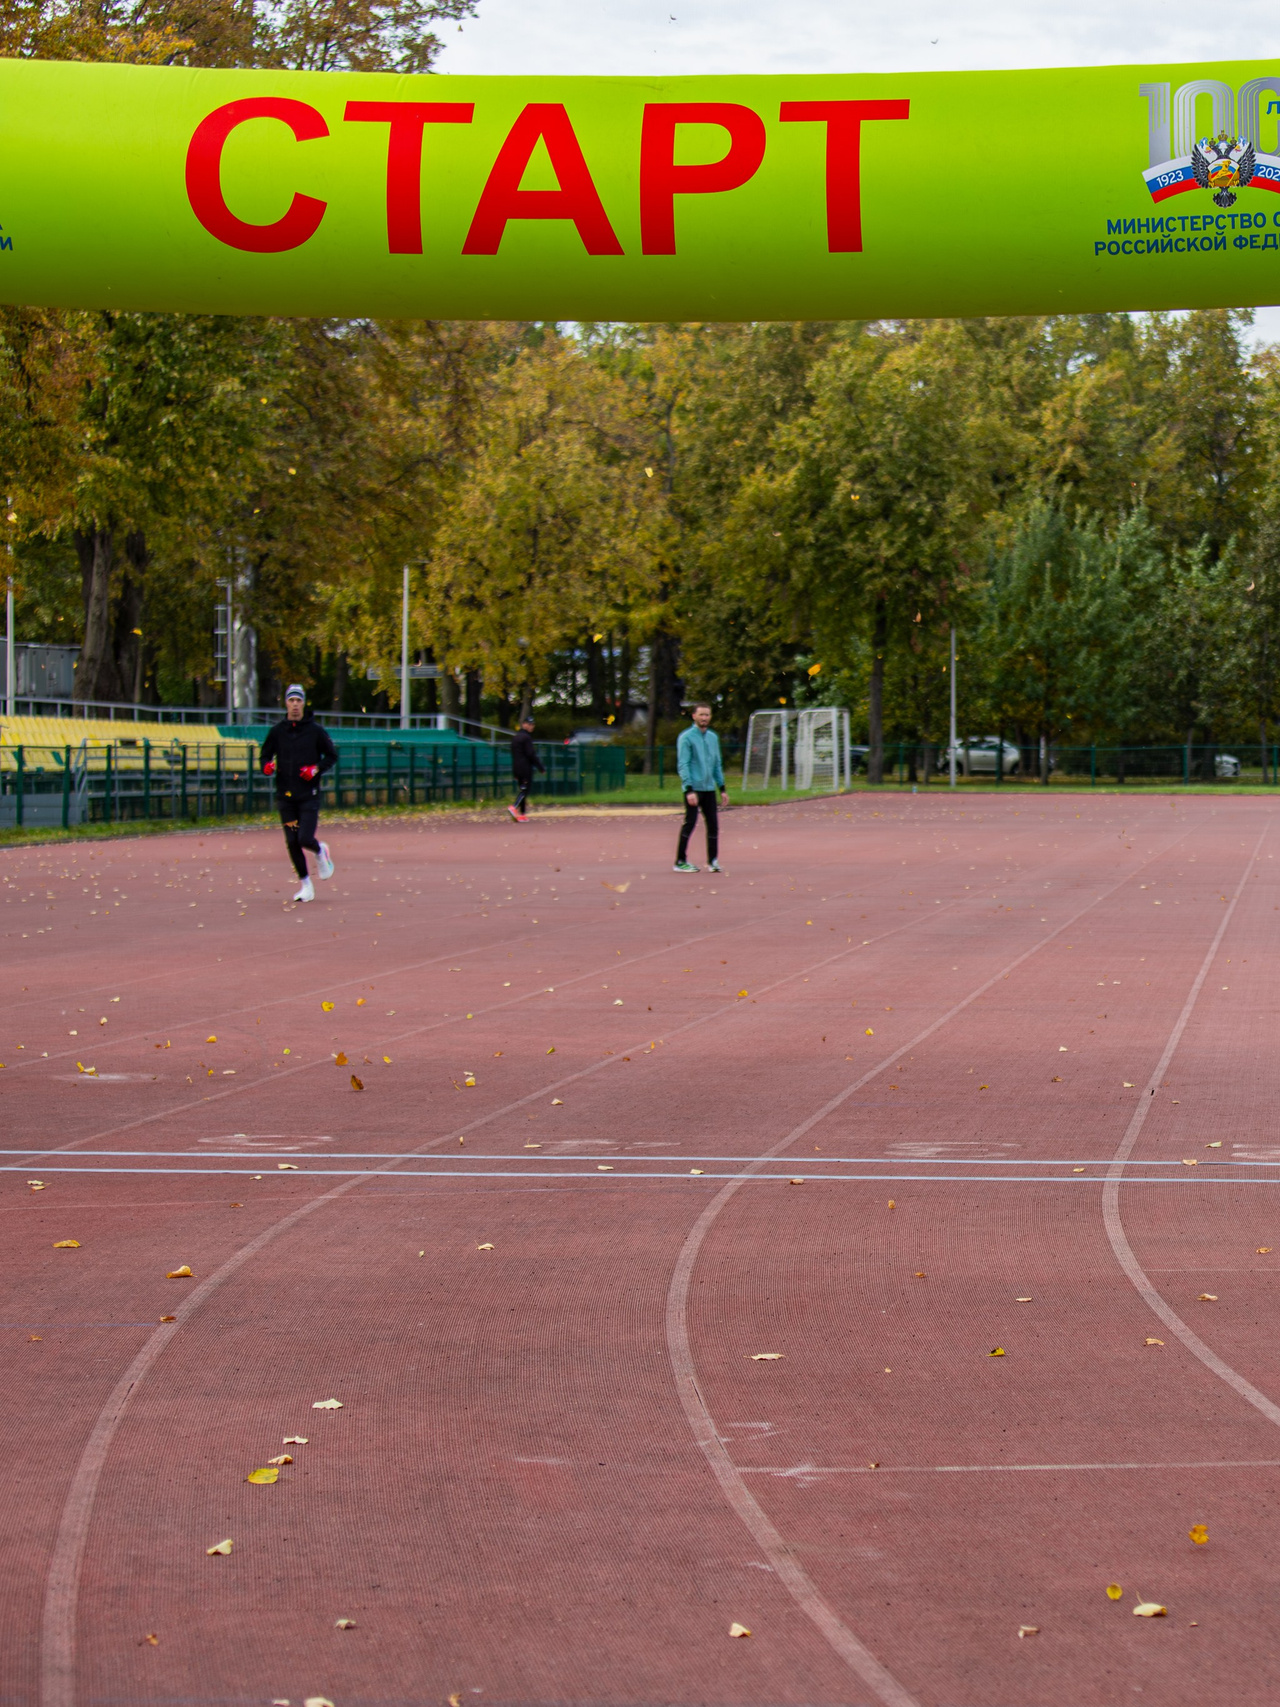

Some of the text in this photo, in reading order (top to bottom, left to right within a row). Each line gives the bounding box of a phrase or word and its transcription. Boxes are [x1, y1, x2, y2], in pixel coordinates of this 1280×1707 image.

[185, 96, 911, 256] СТАРТ
[1156, 170, 1184, 188] 1923
[1106, 211, 1267, 236] МИНИСТЕРСТВО
[1094, 231, 1228, 256] РОССИЙСКОЙ
